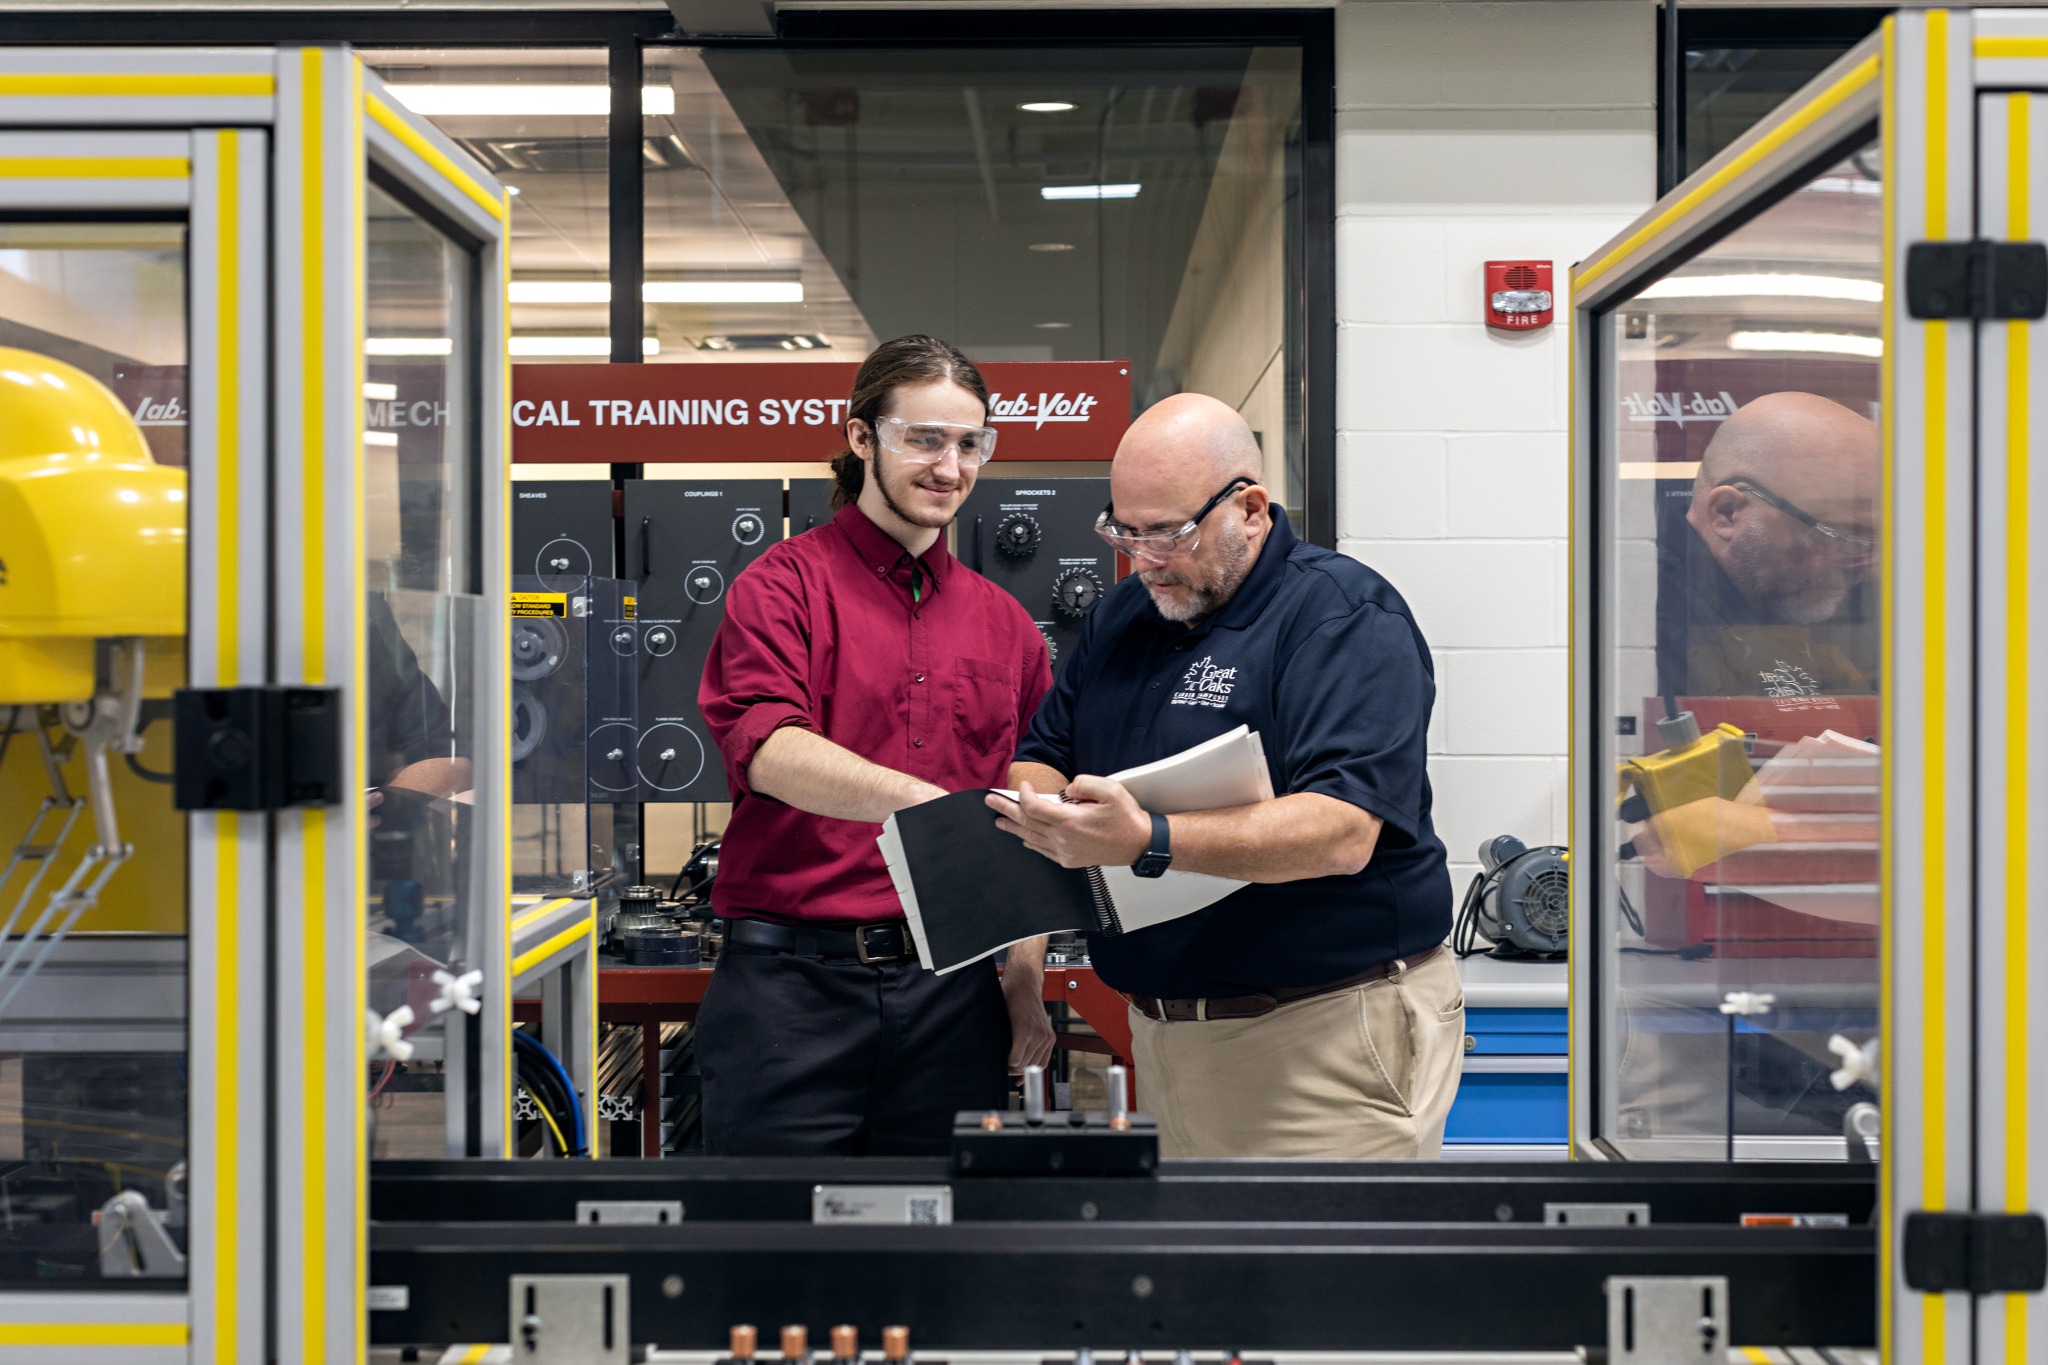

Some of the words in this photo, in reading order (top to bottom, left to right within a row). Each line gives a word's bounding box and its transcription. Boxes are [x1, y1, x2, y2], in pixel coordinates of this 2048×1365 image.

[1506, 314, 1539, 325] FIRE
[588, 398, 749, 426] TRAINING
[1202, 664, 1238, 679] Great
[1199, 678, 1235, 693] Oaks
